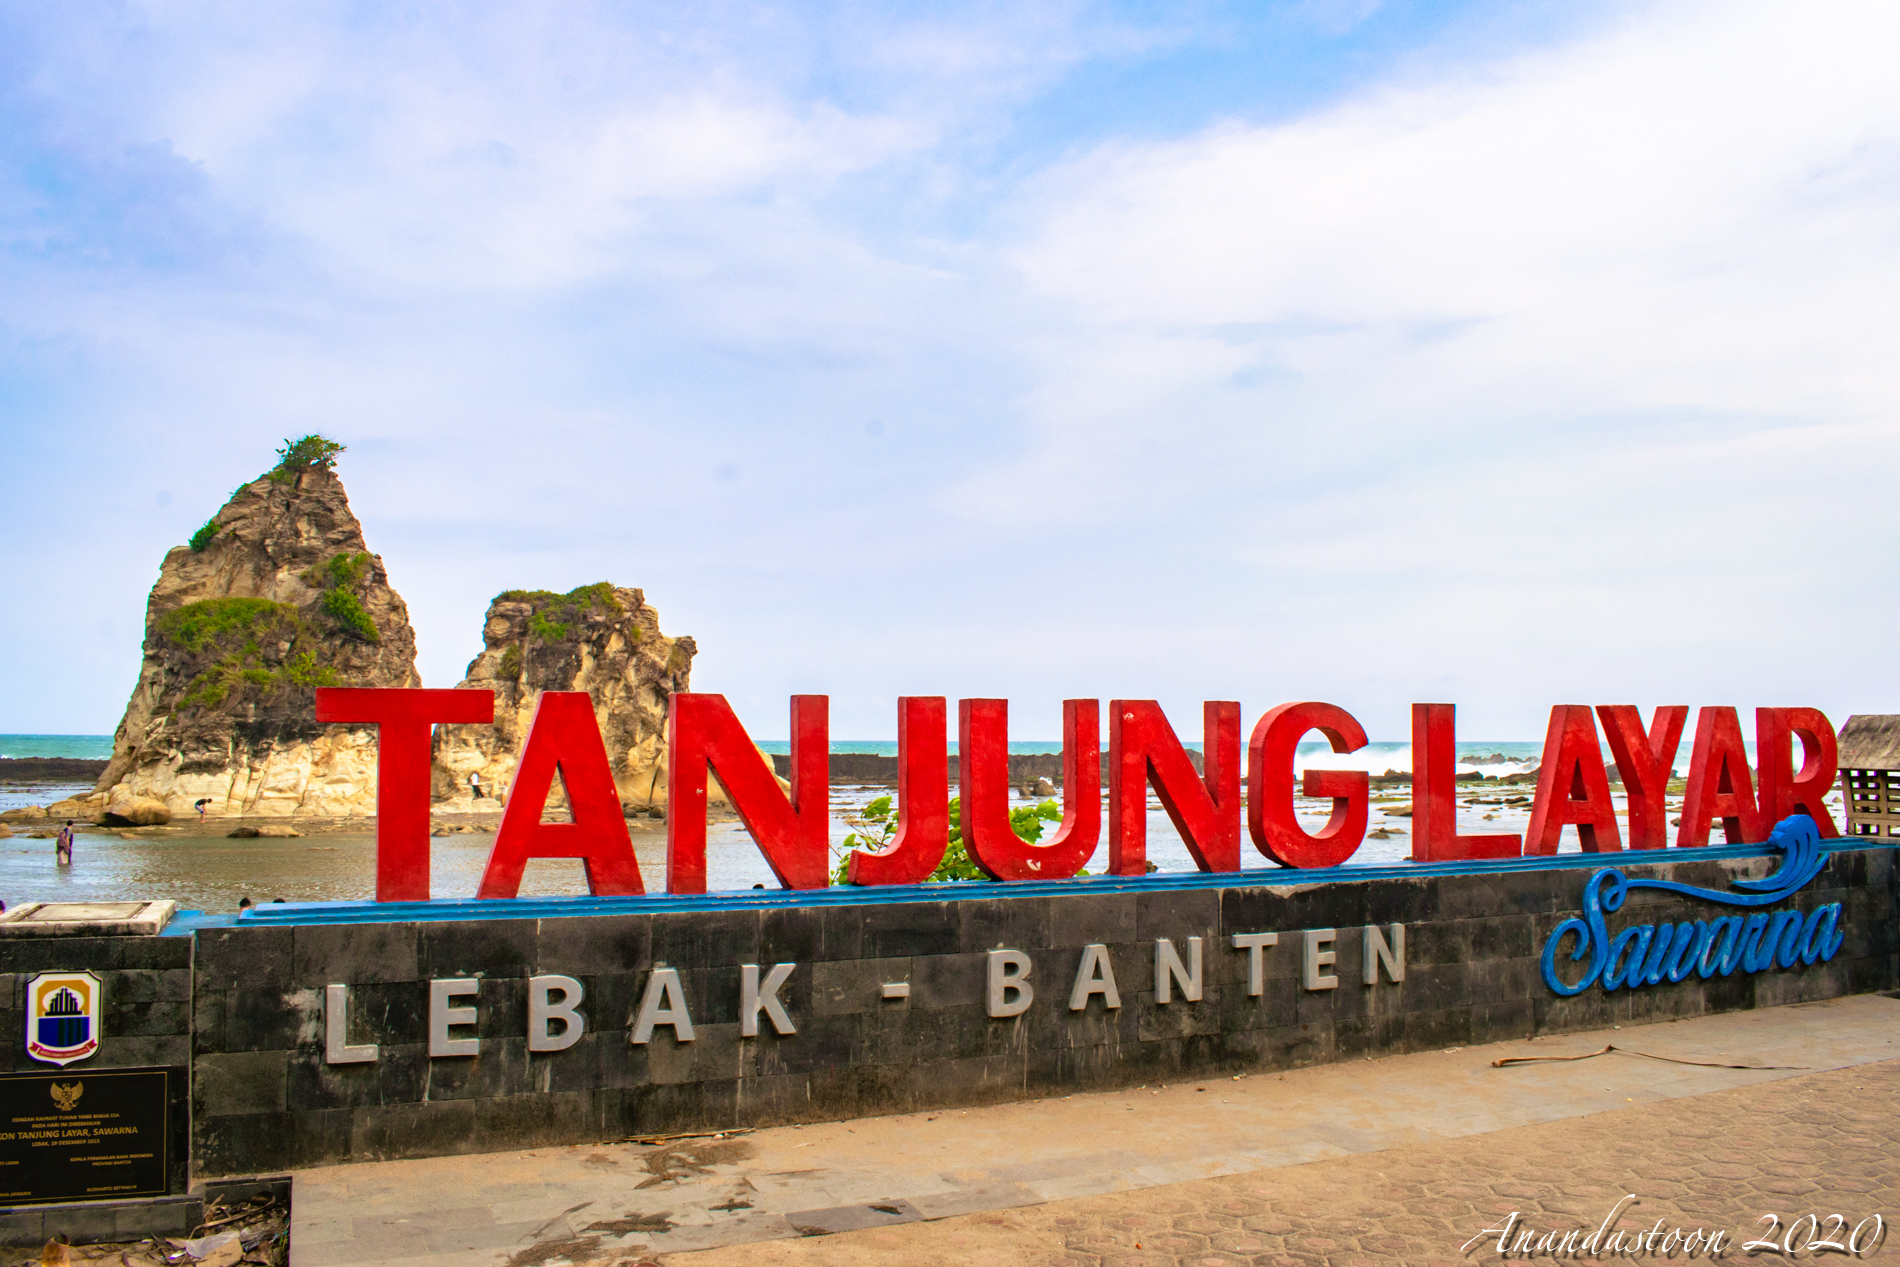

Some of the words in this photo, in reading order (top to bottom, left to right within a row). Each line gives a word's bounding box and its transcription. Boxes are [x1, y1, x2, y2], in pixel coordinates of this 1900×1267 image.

[315, 687, 1369, 902] TANJUNG
[1412, 703, 1841, 862] LAYAR
[325, 962, 797, 1065] LEBAK
[881, 982, 910, 998] -
[986, 923, 1406, 1018] BANTEN
[1541, 867, 1844, 996] Sawarna
[17, 1130, 59, 1140] TANJUNG
[62, 1129, 91, 1138] LAYAR,
[93, 1126, 138, 1136] SAWARNA
